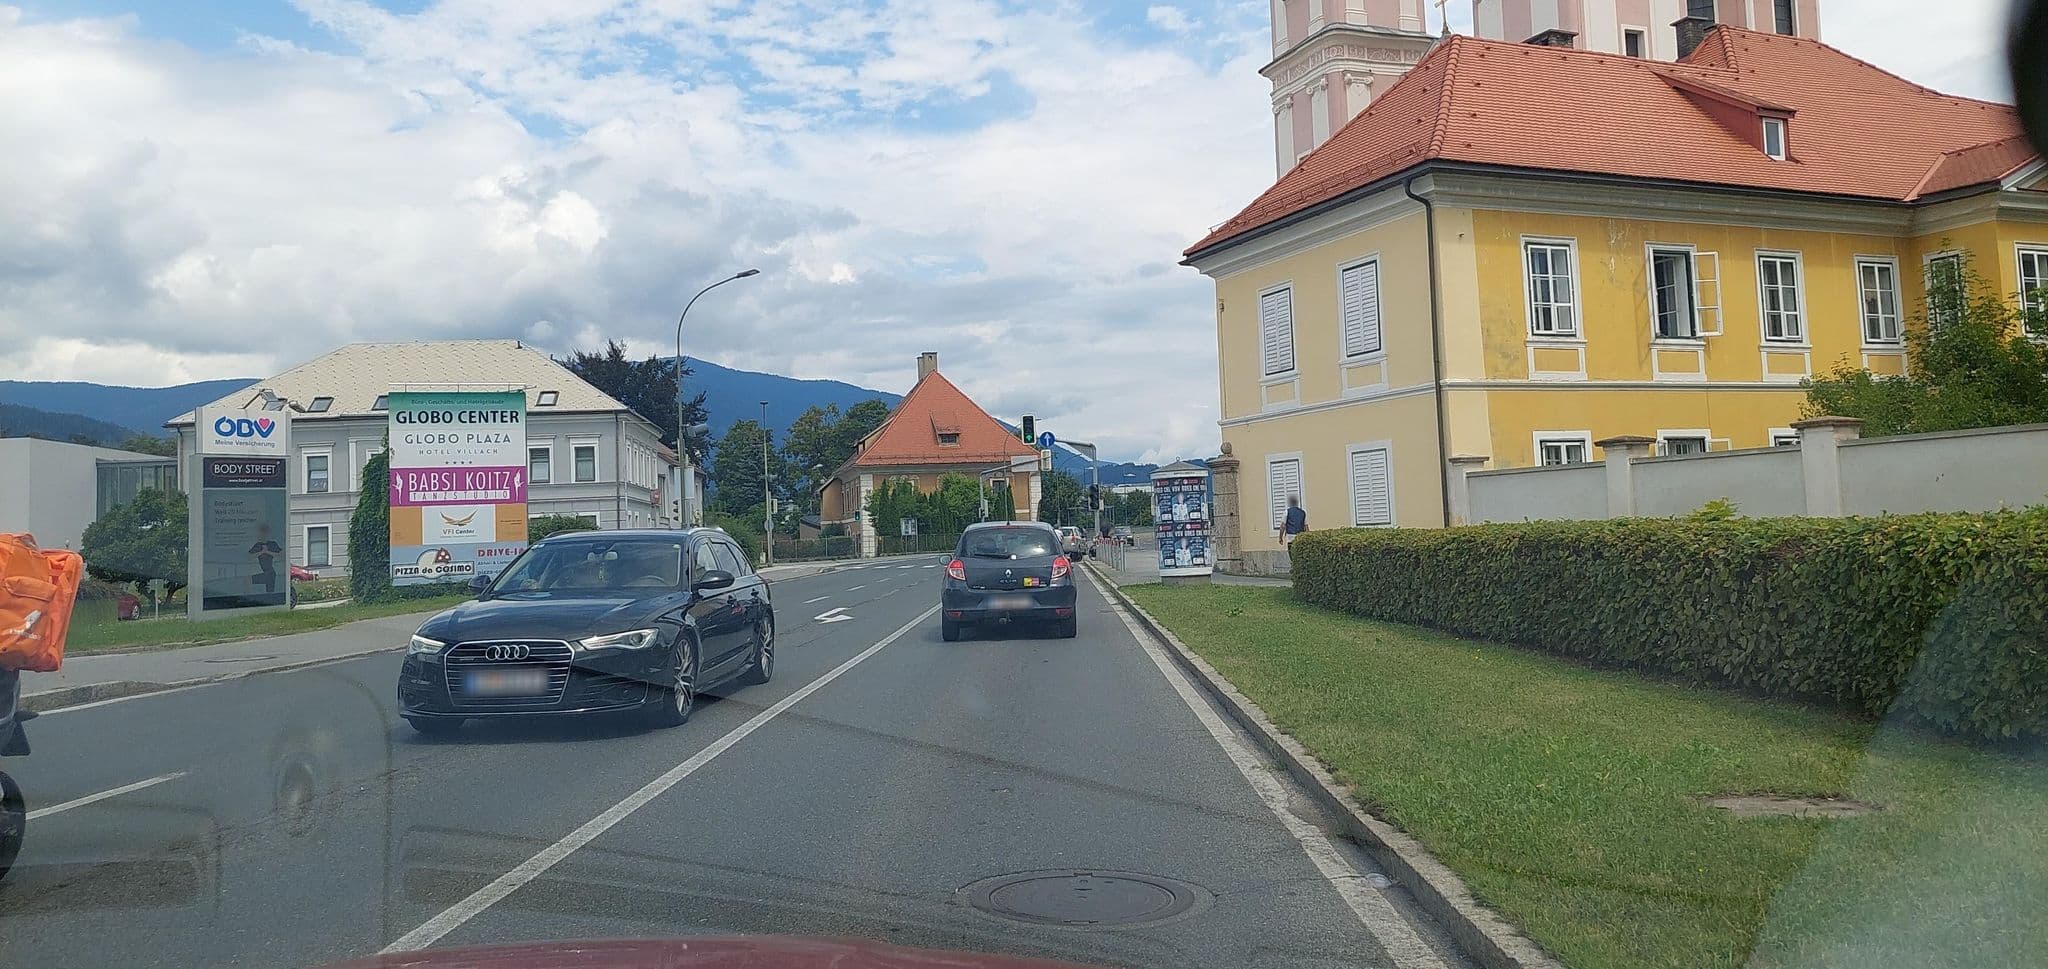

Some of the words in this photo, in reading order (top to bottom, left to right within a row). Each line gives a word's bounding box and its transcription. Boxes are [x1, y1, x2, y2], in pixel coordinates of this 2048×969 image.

[395, 410, 453, 424] GLOBO
[457, 410, 519, 424] CENTER
[235, 440, 275, 448] Versicherung
[404, 434, 460, 444] GLOBO
[466, 433, 511, 443] PLAZA
[214, 464, 243, 474] BODY
[245, 464, 276, 474] STREET
[409, 472, 457, 491] BABSI
[466, 471, 511, 490] KOITZ
[413, 490, 508, 500] TANZSTUDIO
[395, 566, 419, 575] PIZZA
[435, 564, 472, 574] COSIMO
